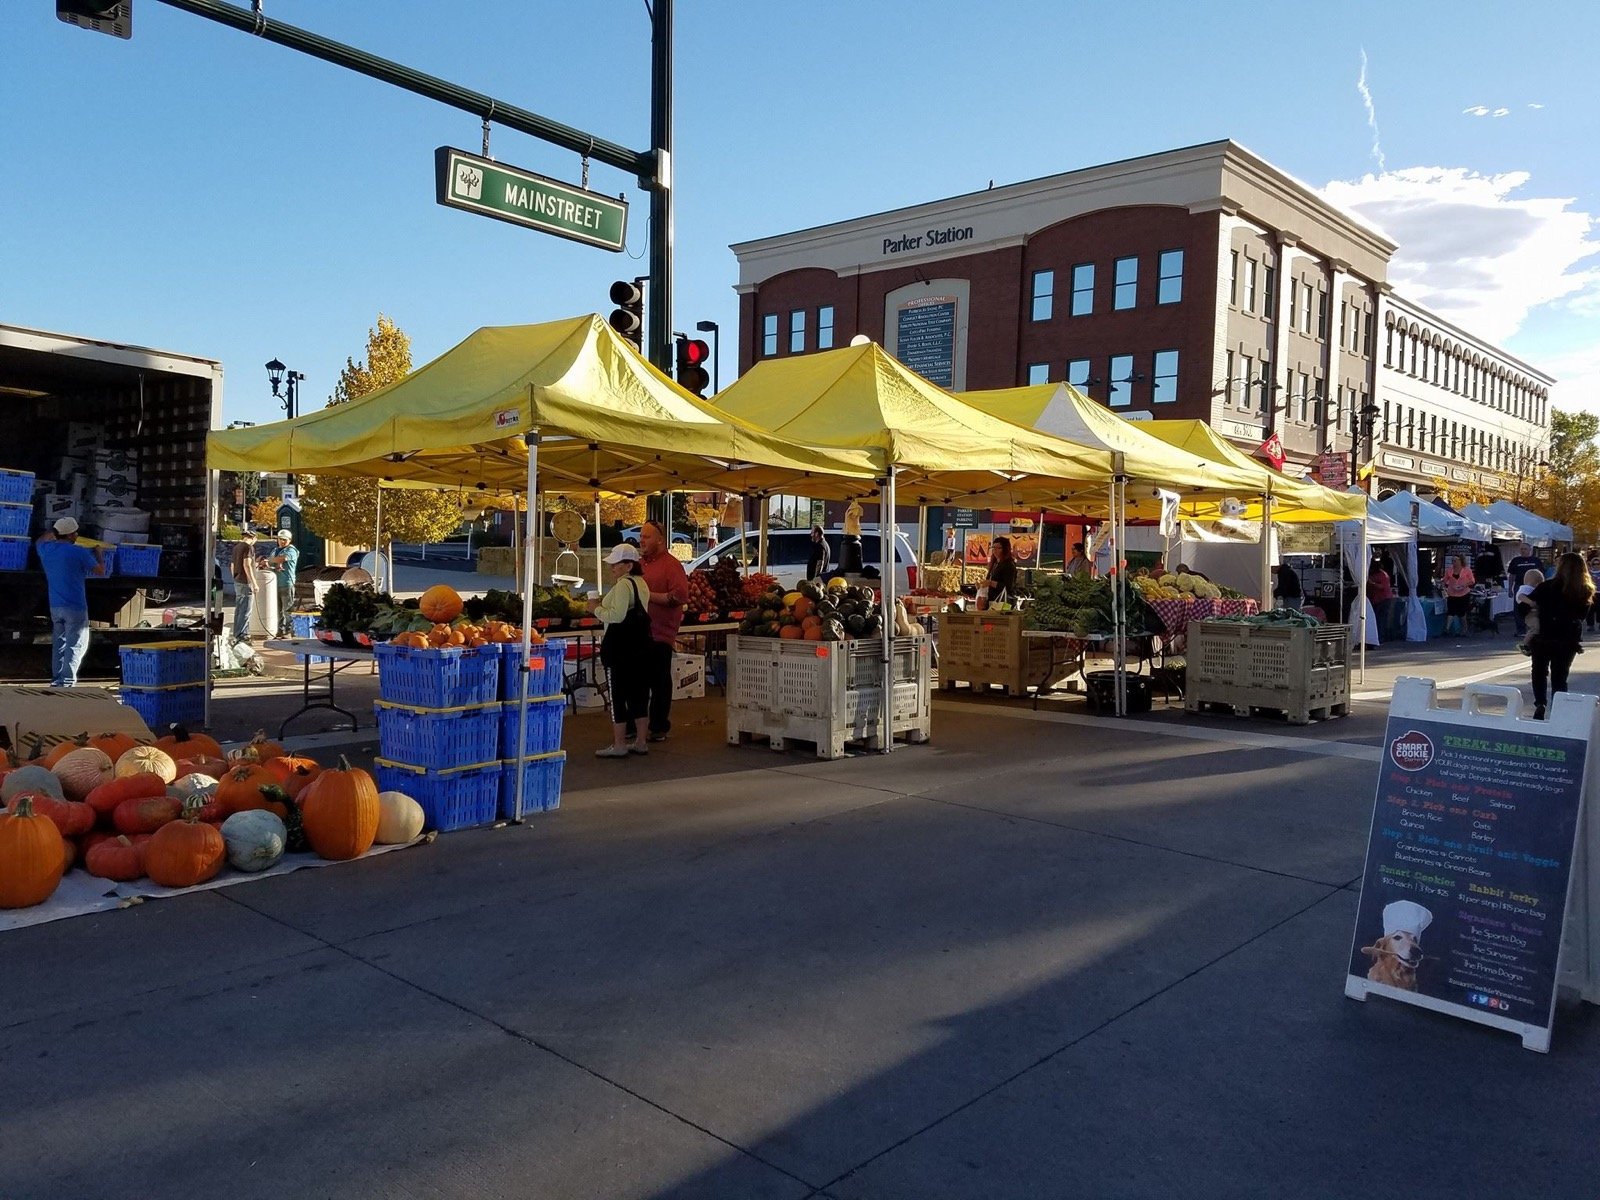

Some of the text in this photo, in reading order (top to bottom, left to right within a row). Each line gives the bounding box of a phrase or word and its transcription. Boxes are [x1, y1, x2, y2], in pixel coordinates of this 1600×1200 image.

[505, 182, 602, 230] MAINSTREET
[882, 227, 973, 254] Parker Station
[908, 296, 945, 306] PROFESSIONAL
[1396, 750, 1428, 758] COOKIE
[1443, 735, 1566, 761] TREAT SMARTER
[1527, 761, 1543, 770] YOU
[1405, 786, 1432, 796] Chicken
[1451, 793, 1469, 802] Beef
[1489, 799, 1515, 810] Salmon
[1401, 808, 1443, 822] Brown Rice
[1449, 807, 1467, 815] one
[1472, 809, 1498, 821] Carb
[1399, 818, 1424, 829] Quinoa
[1472, 820, 1491, 830] Oats
[1471, 831, 1496, 843] Barley
[1396, 841, 1439, 856] Cranberries
[1448, 850, 1477, 863] Carrots
[1394, 851, 1434, 866] Blueberries
[1444, 861, 1468, 872] Green
[1468, 866, 1492, 878] Beans
[1522, 853, 1560, 869] Veggie
[1379, 864, 1456, 887] Smart Cookies
[1394, 880, 1413, 889] each
[1468, 883, 1539, 907] Rabbit Jerky
[1528, 909, 1546, 920] bag
[1483, 928, 1509, 942] Sports
[1509, 934, 1527, 948] Dog
